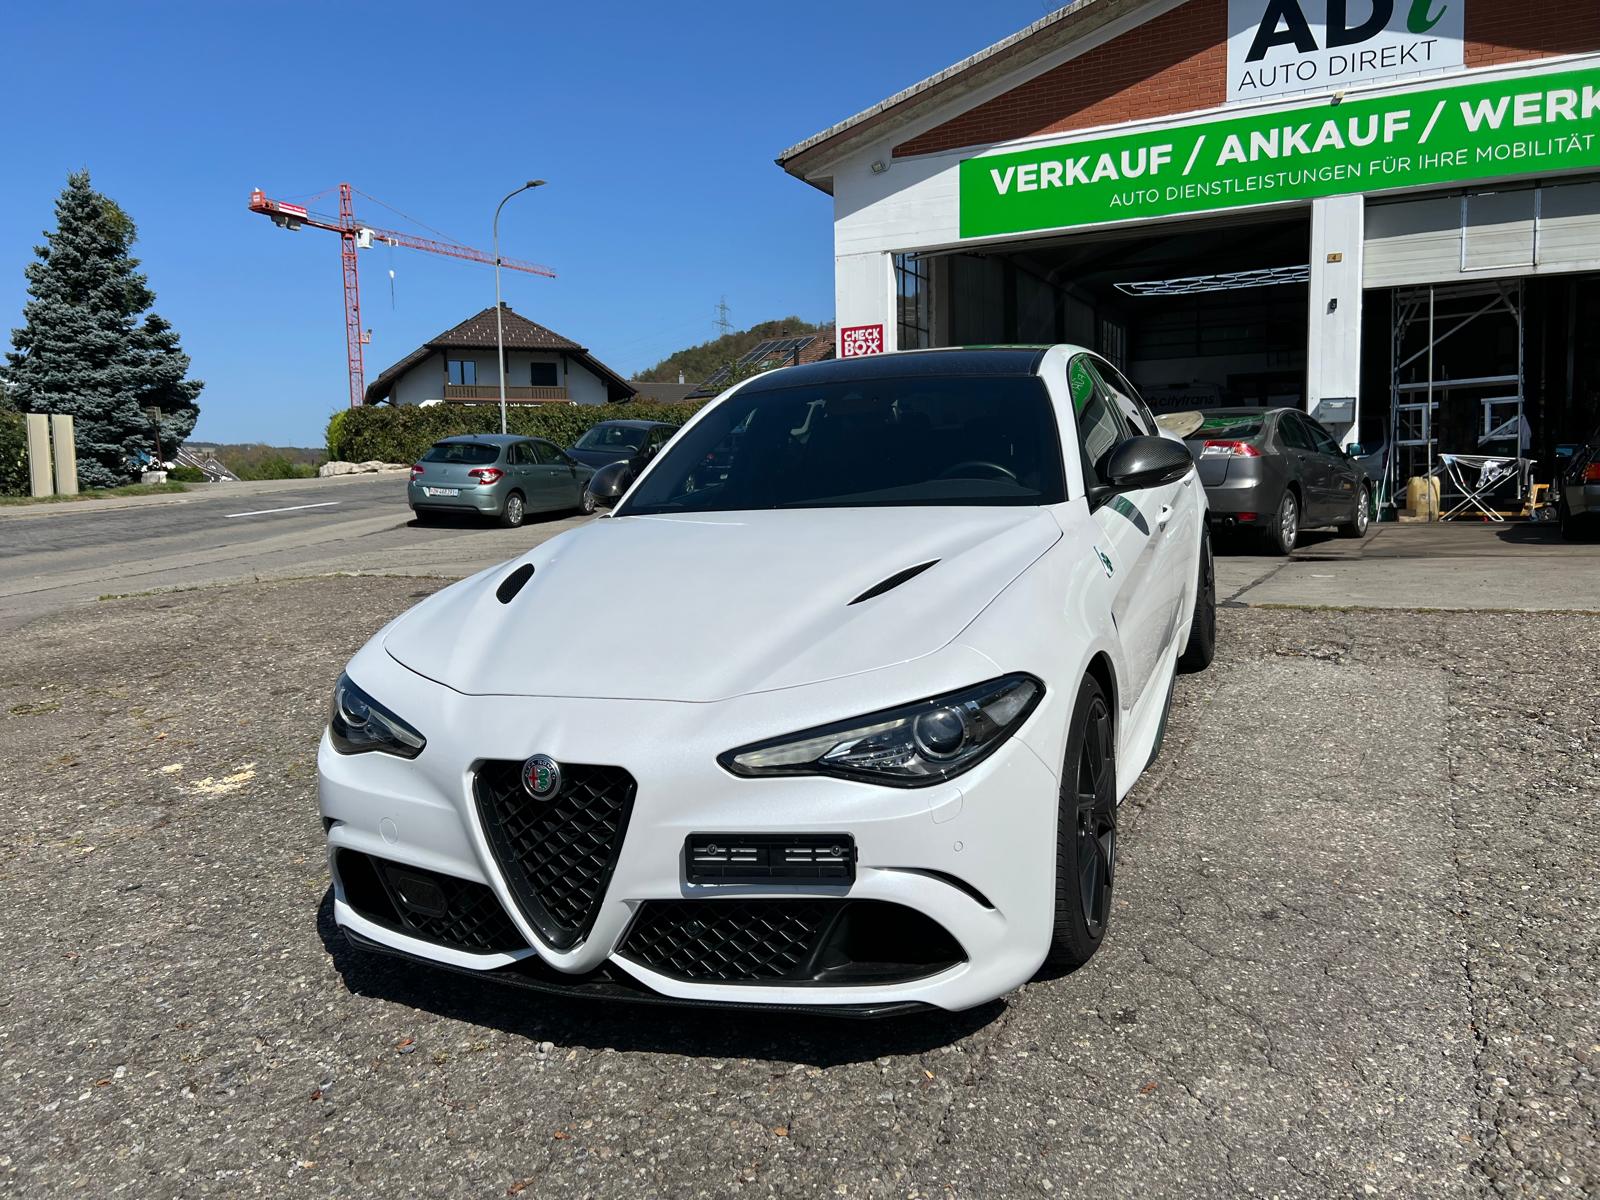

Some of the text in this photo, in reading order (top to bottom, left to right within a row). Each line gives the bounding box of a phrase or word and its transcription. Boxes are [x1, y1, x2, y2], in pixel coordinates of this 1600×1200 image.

[1238, 39, 1438, 91] AUTO DIREKT
[990, 144, 1173, 195] VERKAUF
[1182, 135, 1206, 176] /
[1215, 110, 1411, 166] ANKAUF
[1417, 100, 1447, 144] /
[1109, 133, 1595, 207] AUTO DIENSTLEISTUNGEN FÜR IHRE MOBILITÄT
[844, 328, 880, 341] CHECK
[845, 339, 880, 355] BOX
[538, 760, 556, 780] ROMEO
